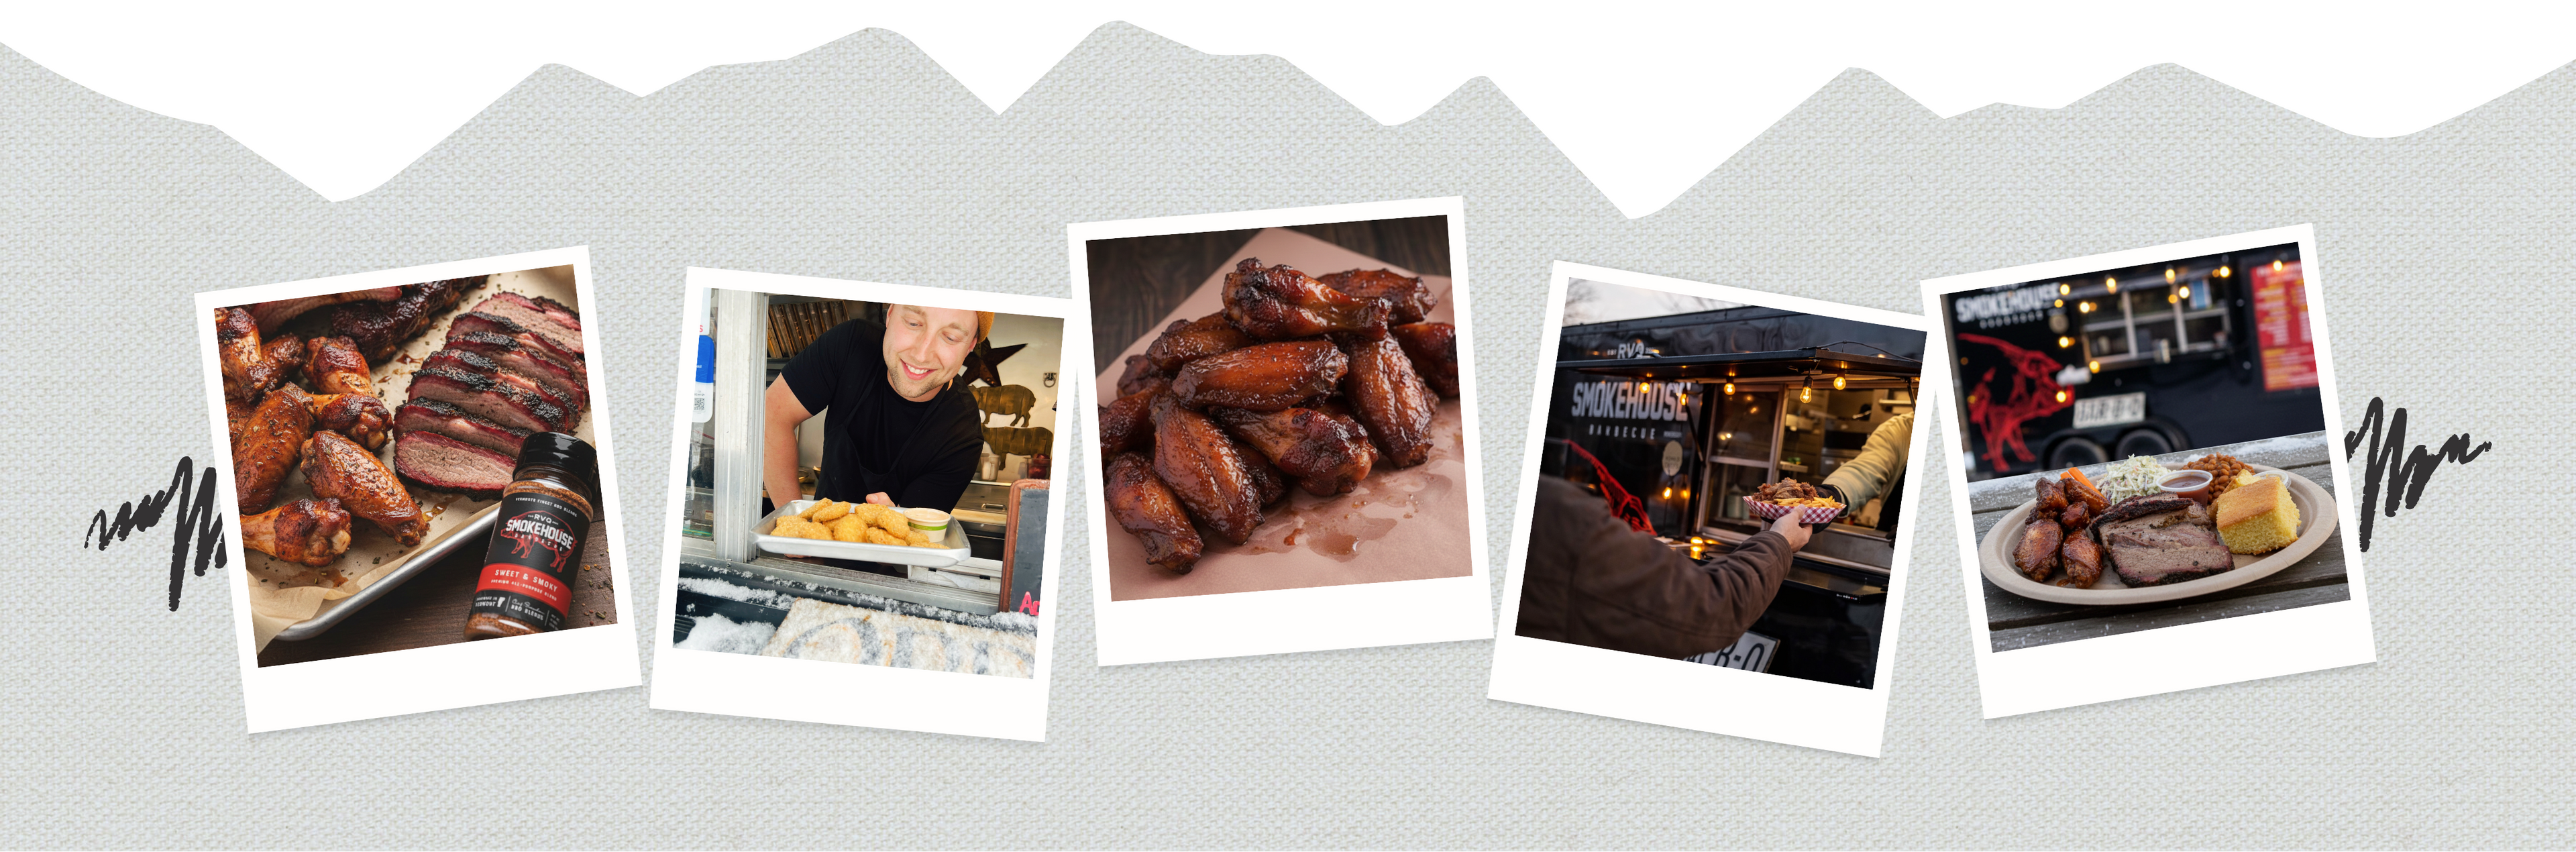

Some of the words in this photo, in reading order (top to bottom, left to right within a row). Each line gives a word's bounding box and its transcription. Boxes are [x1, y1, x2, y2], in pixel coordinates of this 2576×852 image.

[1589, 424, 1656, 439] BARBECUE
[534, 513, 552, 524] RVQ
[506, 519, 574, 549] SMOKEHOUSE
[494, 569, 520, 578] SWEET
[533, 576, 558, 592] SMOKY
